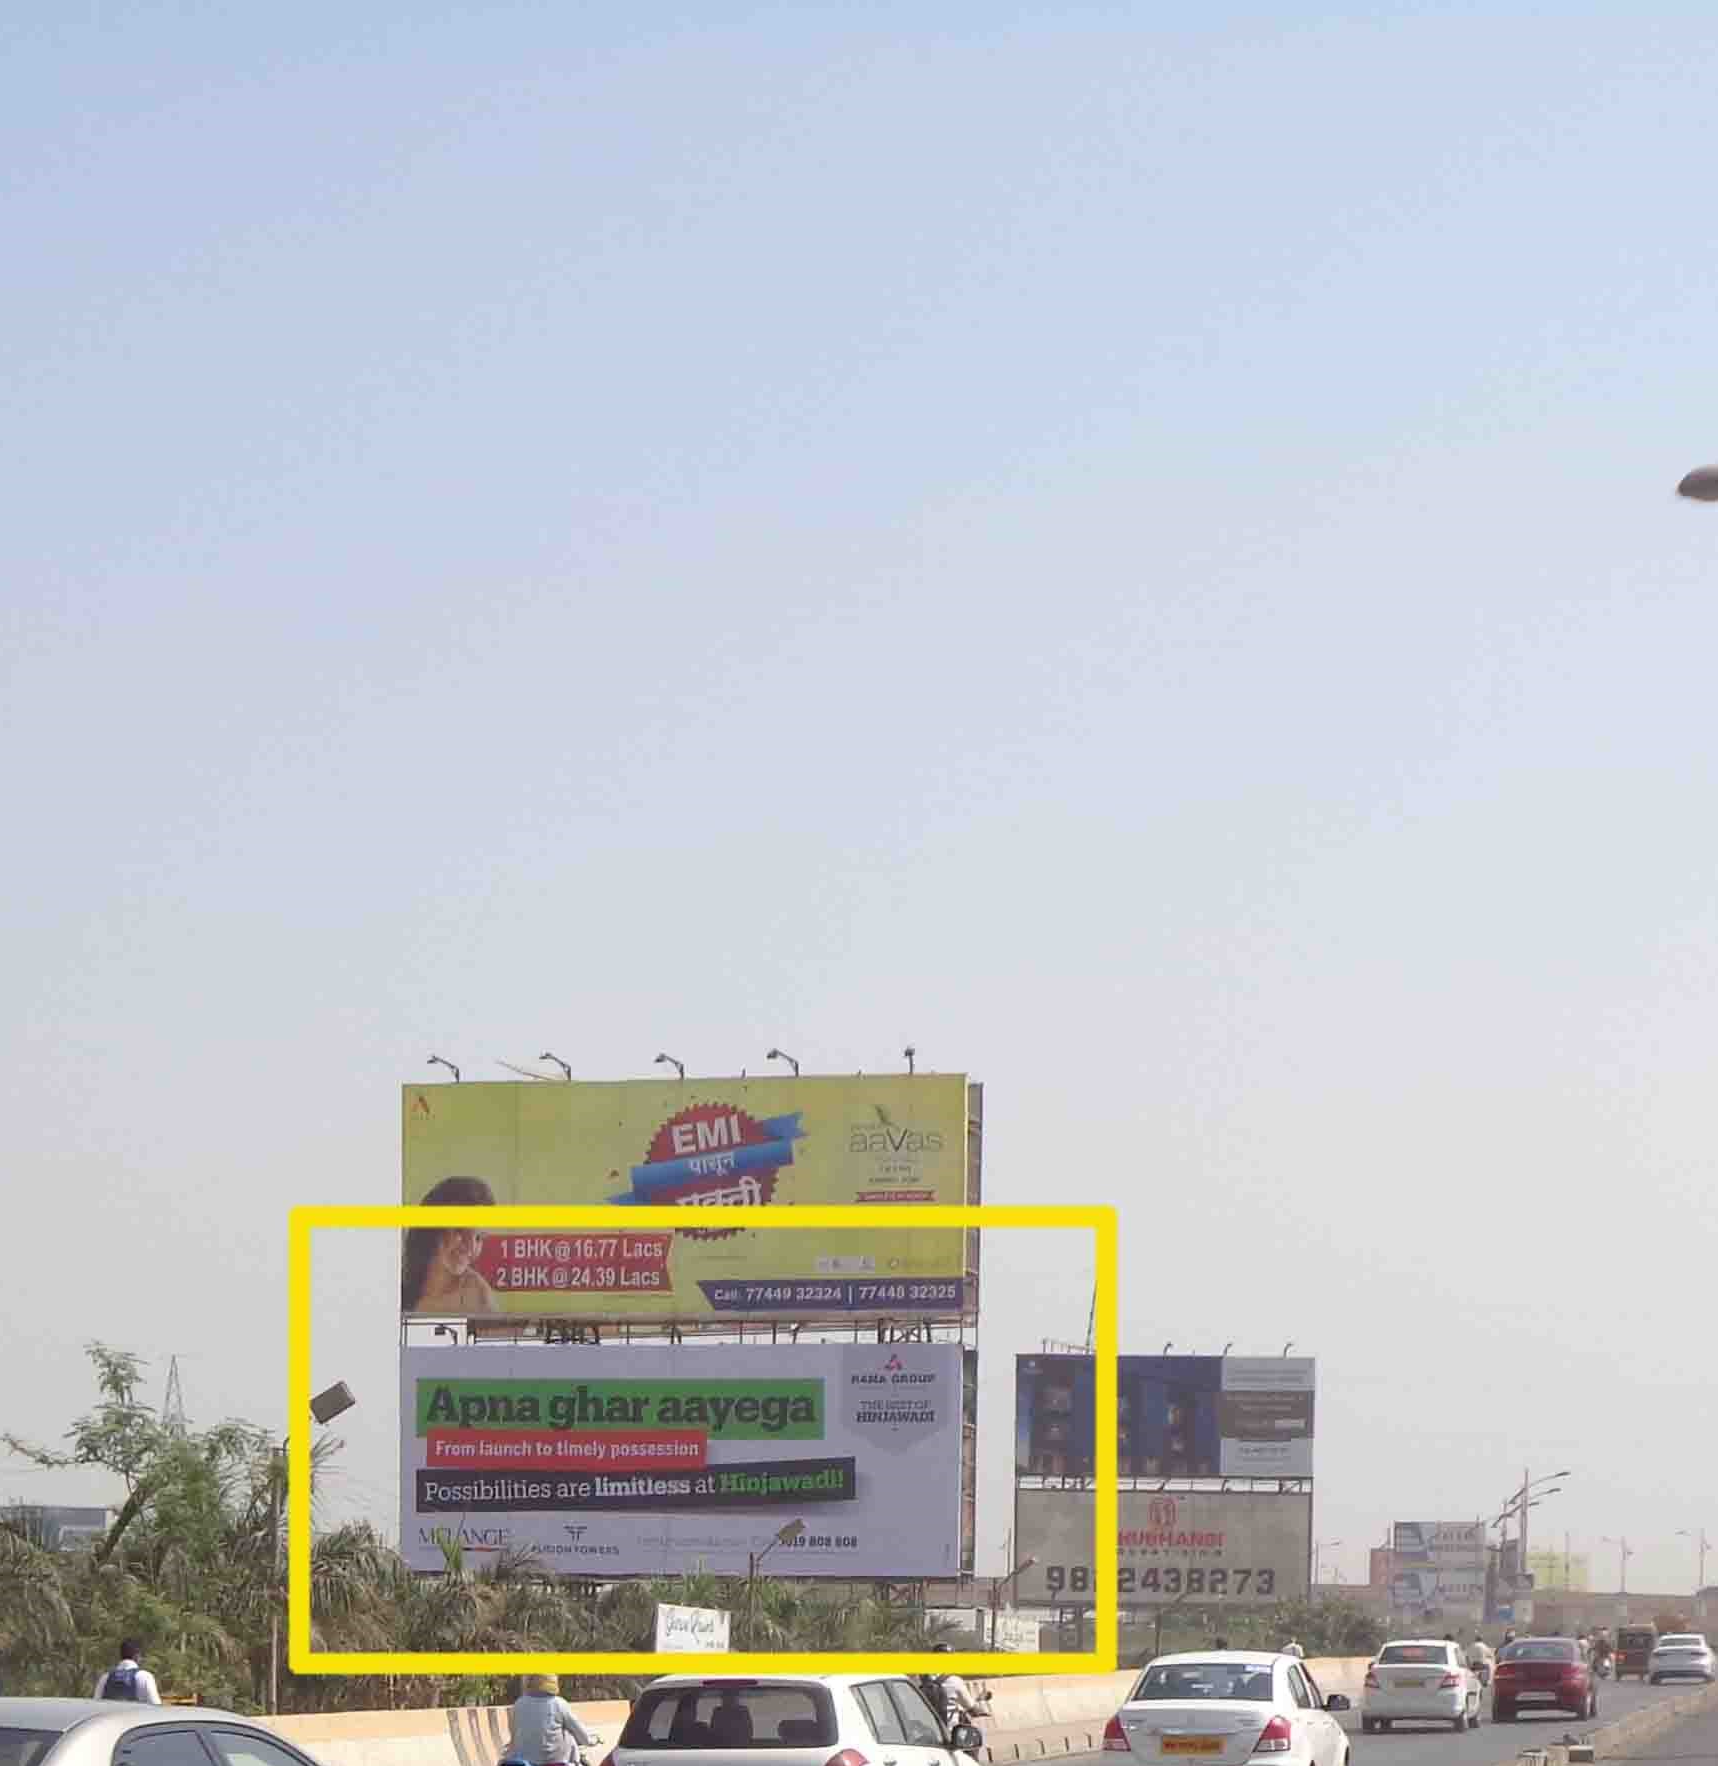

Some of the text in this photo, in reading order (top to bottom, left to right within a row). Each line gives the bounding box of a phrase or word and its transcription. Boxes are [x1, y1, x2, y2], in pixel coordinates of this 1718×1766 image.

[672, 1114, 742, 1155] EMI
[500, 1239, 509, 1259] 1
[514, 1239, 552, 1259] BHK
[574, 1239, 618, 1259] 16.77
[623, 1239, 663, 1258] Lacs
[496, 1267, 508, 1287] 2
[511, 1267, 549, 1287] BHK
[571, 1267, 616, 1287] 24.39
[620, 1267, 661, 1286] Lacs
[427, 1385, 817, 1432] Apna ghar aayega
[435, 1440, 699, 1460] From launch to timely possession
[424, 1478, 552, 1501] Possibilities
[557, 1483, 591, 1498] are
[595, 1475, 690, 1497] limitless
[695, 1476, 716, 1495] at
[1045, 1565, 1276, 1595] 982438273
